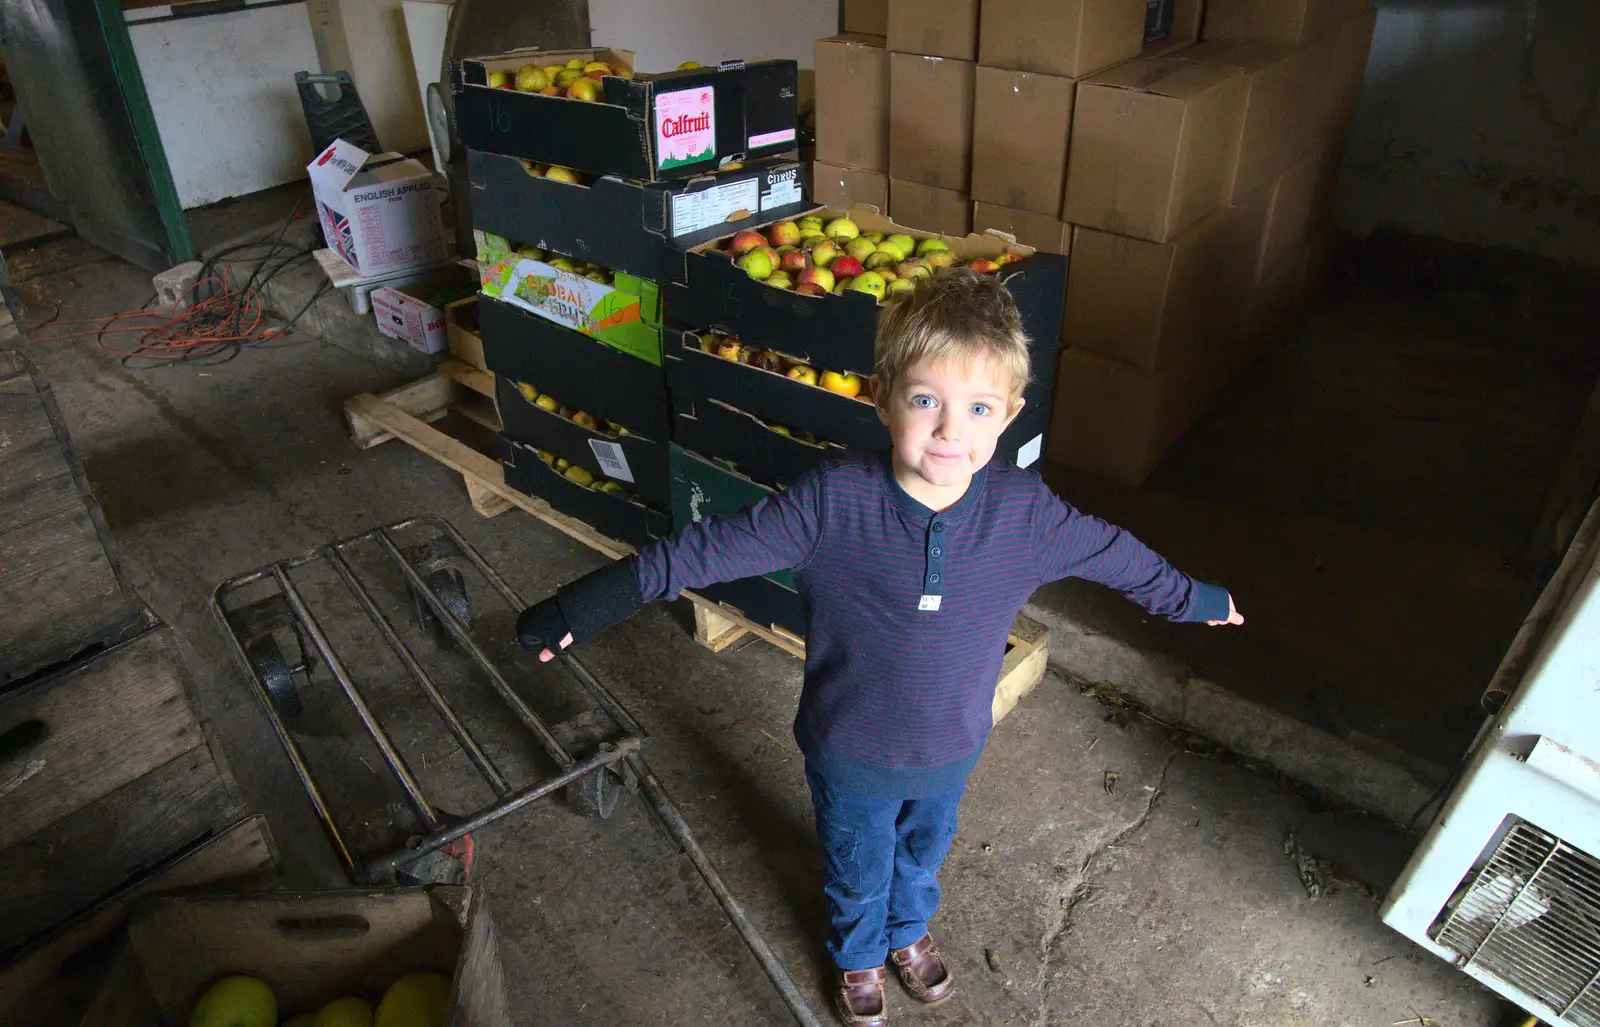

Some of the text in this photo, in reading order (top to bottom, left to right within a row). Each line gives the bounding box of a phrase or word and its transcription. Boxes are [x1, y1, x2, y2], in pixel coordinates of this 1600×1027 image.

[488, 98, 511, 133] 16
[661, 111, 711, 138] Calfruit
[767, 169, 797, 185] CITRUS
[354, 182, 431, 203] ENGLISH APPLES
[603, 295, 624, 323] 16
[721, 281, 744, 319] 15
